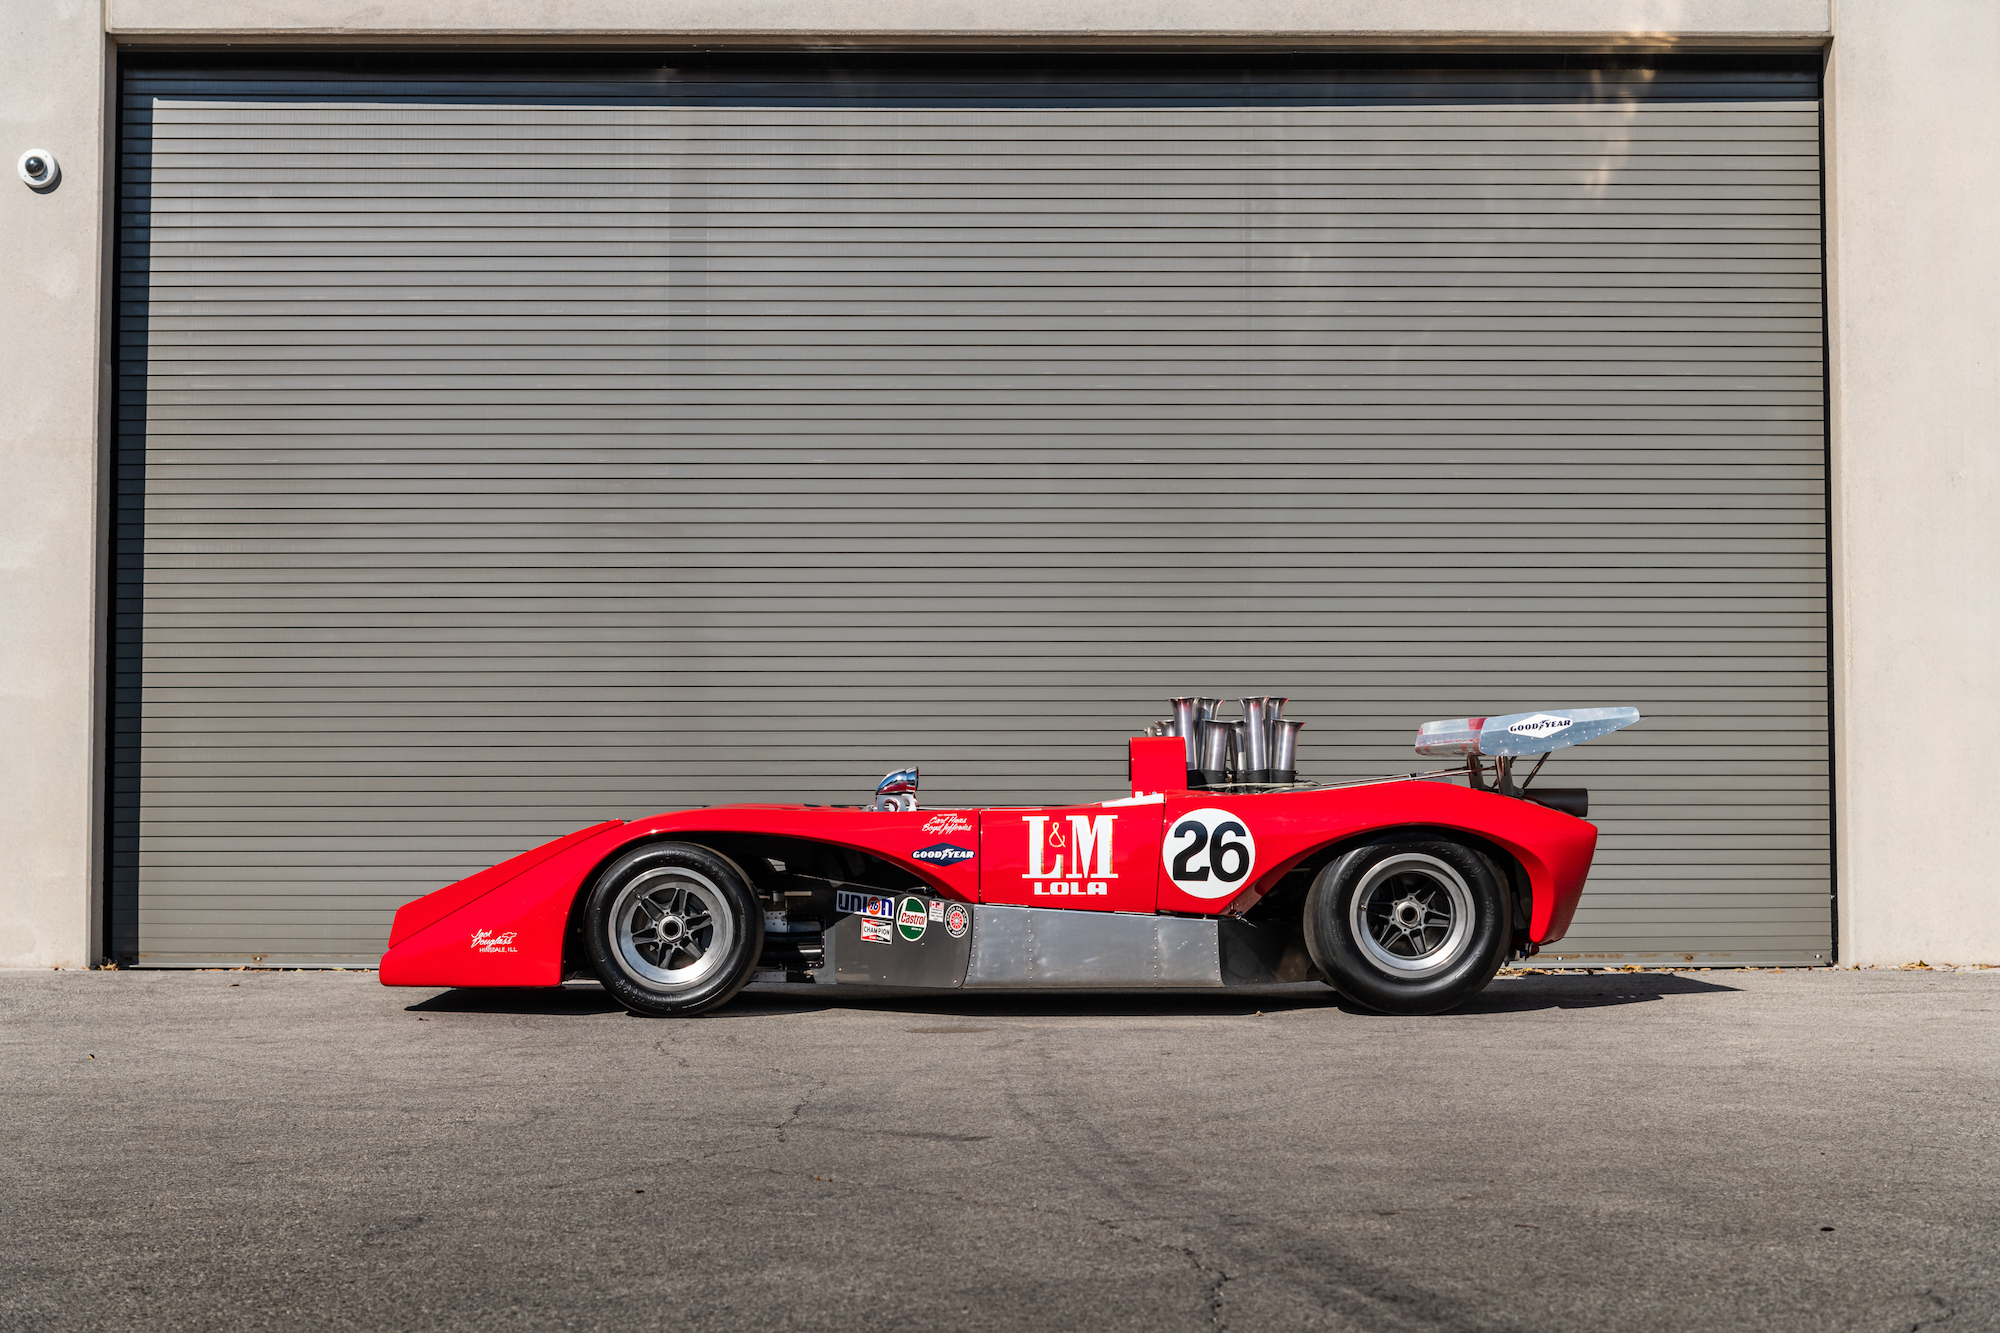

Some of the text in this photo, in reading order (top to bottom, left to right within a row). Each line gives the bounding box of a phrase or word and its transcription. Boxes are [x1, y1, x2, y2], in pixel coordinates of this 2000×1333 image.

[1510, 719, 1571, 731] GOODYEAR
[929, 816, 949, 824] Carl
[922, 823, 944, 834] Boyd
[913, 849, 974, 860] GOODYEAR
[1173, 820, 1249, 882] 26
[1034, 882, 1107, 895] LOLA
[870, 901, 878, 910] 76
[901, 912, 926, 926] Castrol
[471, 929, 492, 938] Jack
[864, 926, 889, 936] CHAMPION
